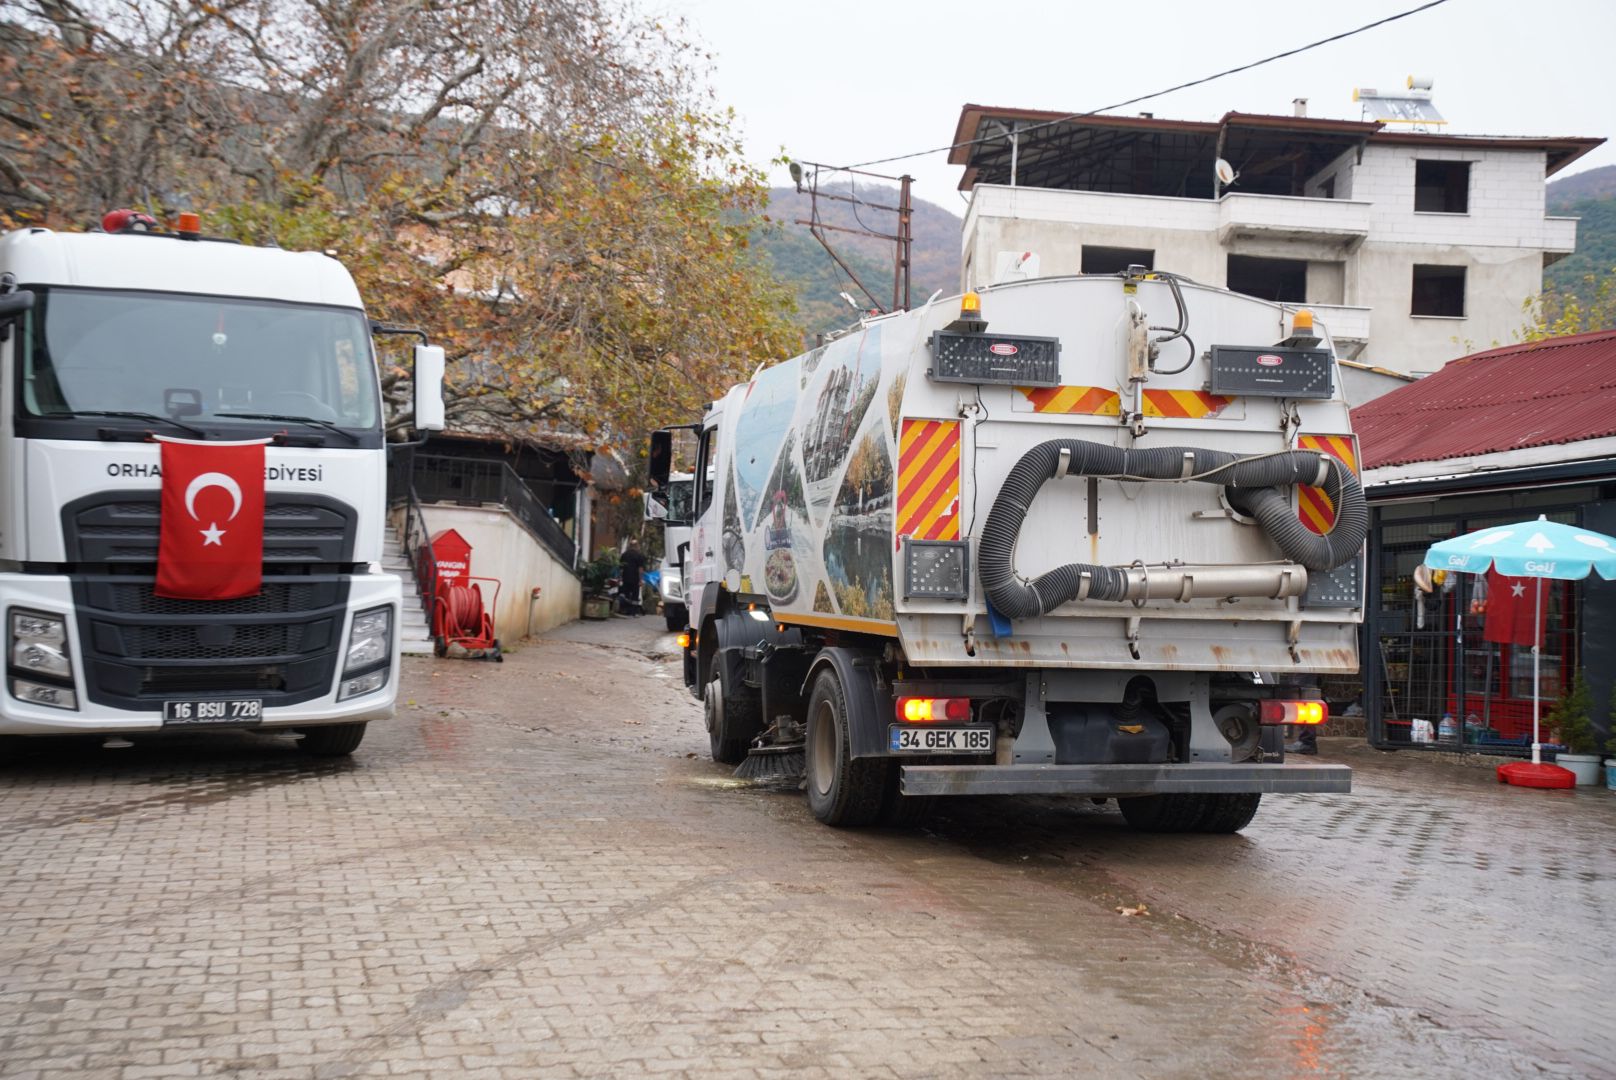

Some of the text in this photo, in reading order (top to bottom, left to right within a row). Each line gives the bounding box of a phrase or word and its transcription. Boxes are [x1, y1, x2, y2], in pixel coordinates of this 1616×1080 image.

[174, 701, 259, 718] 16 BSU 728
[900, 731, 989, 748] 34 GEK 185
